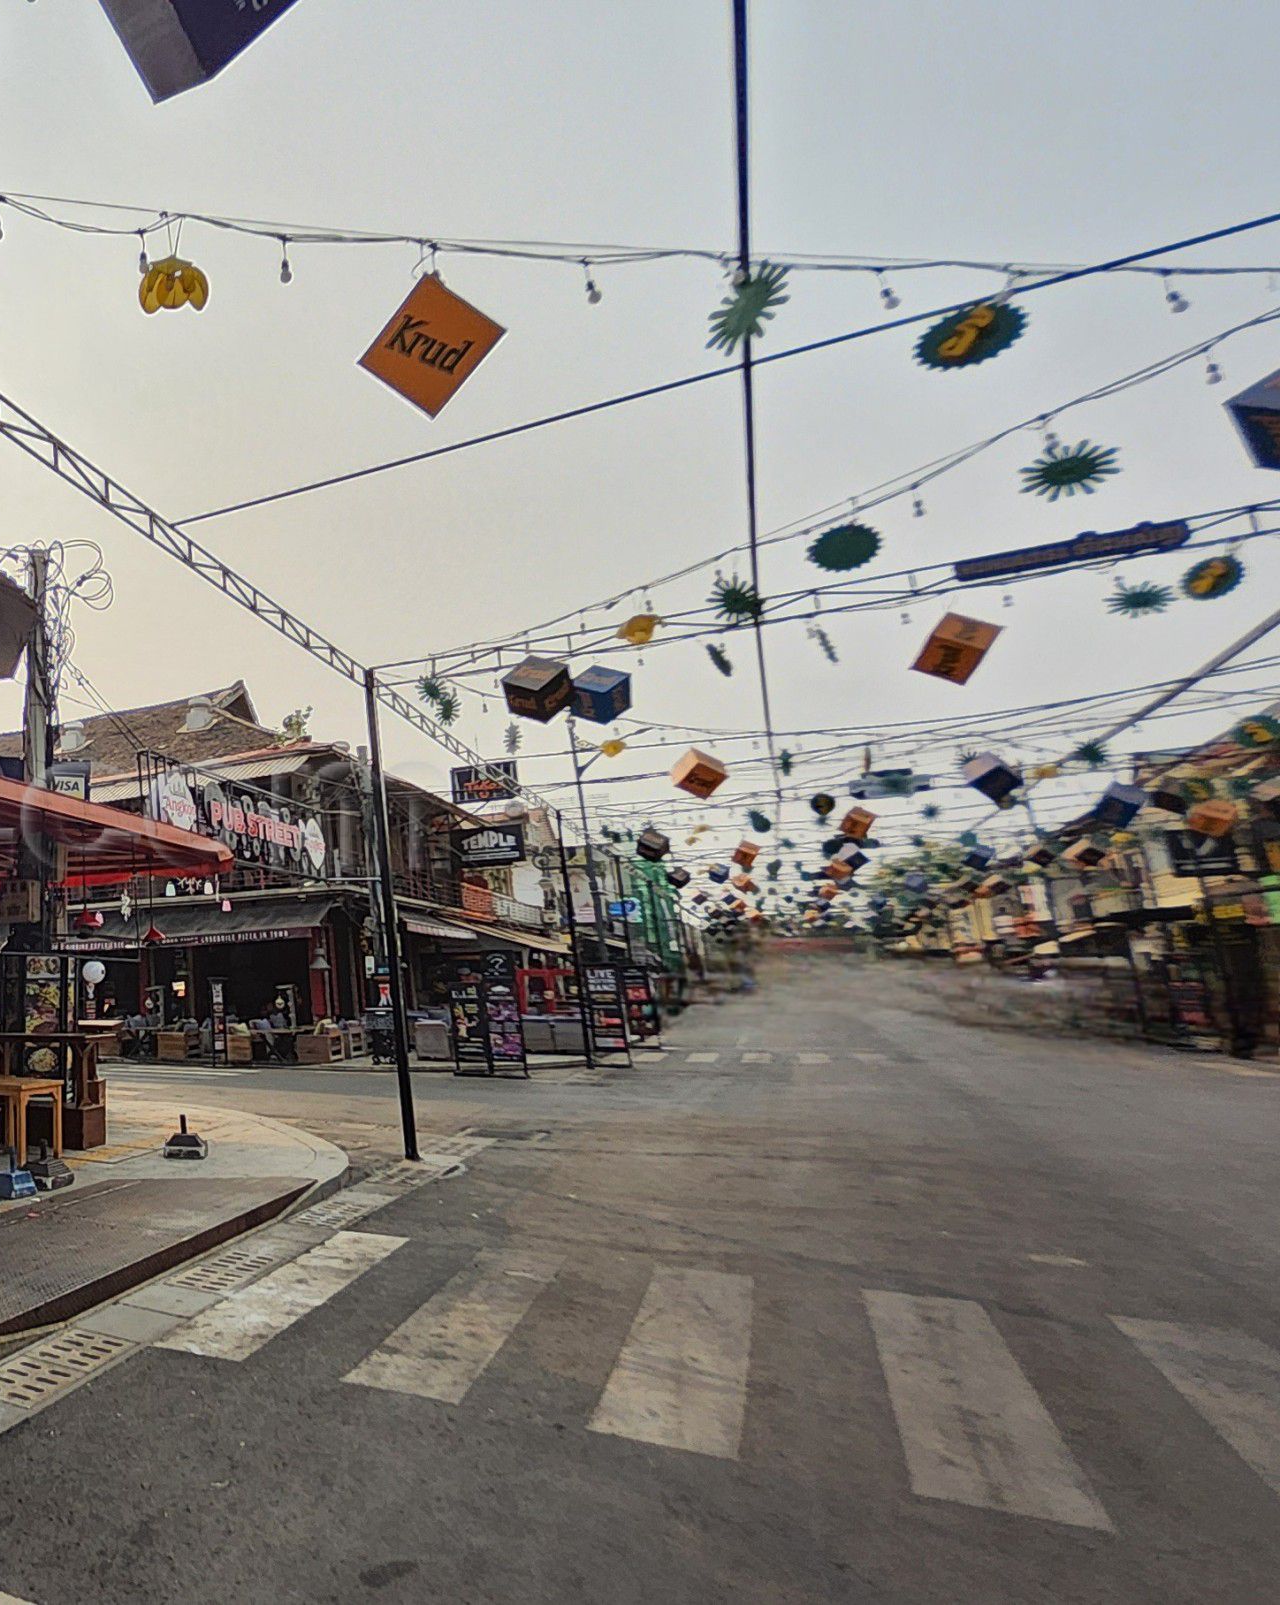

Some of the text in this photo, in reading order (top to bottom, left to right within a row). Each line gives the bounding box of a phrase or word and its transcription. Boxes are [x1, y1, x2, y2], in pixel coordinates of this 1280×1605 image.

[384, 313, 475, 376] Krud
[51, 780, 80, 791] VISA
[210, 800, 246, 834] PUB
[248, 812, 302, 850] STREET
[461, 830, 517, 850] TEMPLE
[586, 968, 616, 979] LIVE
